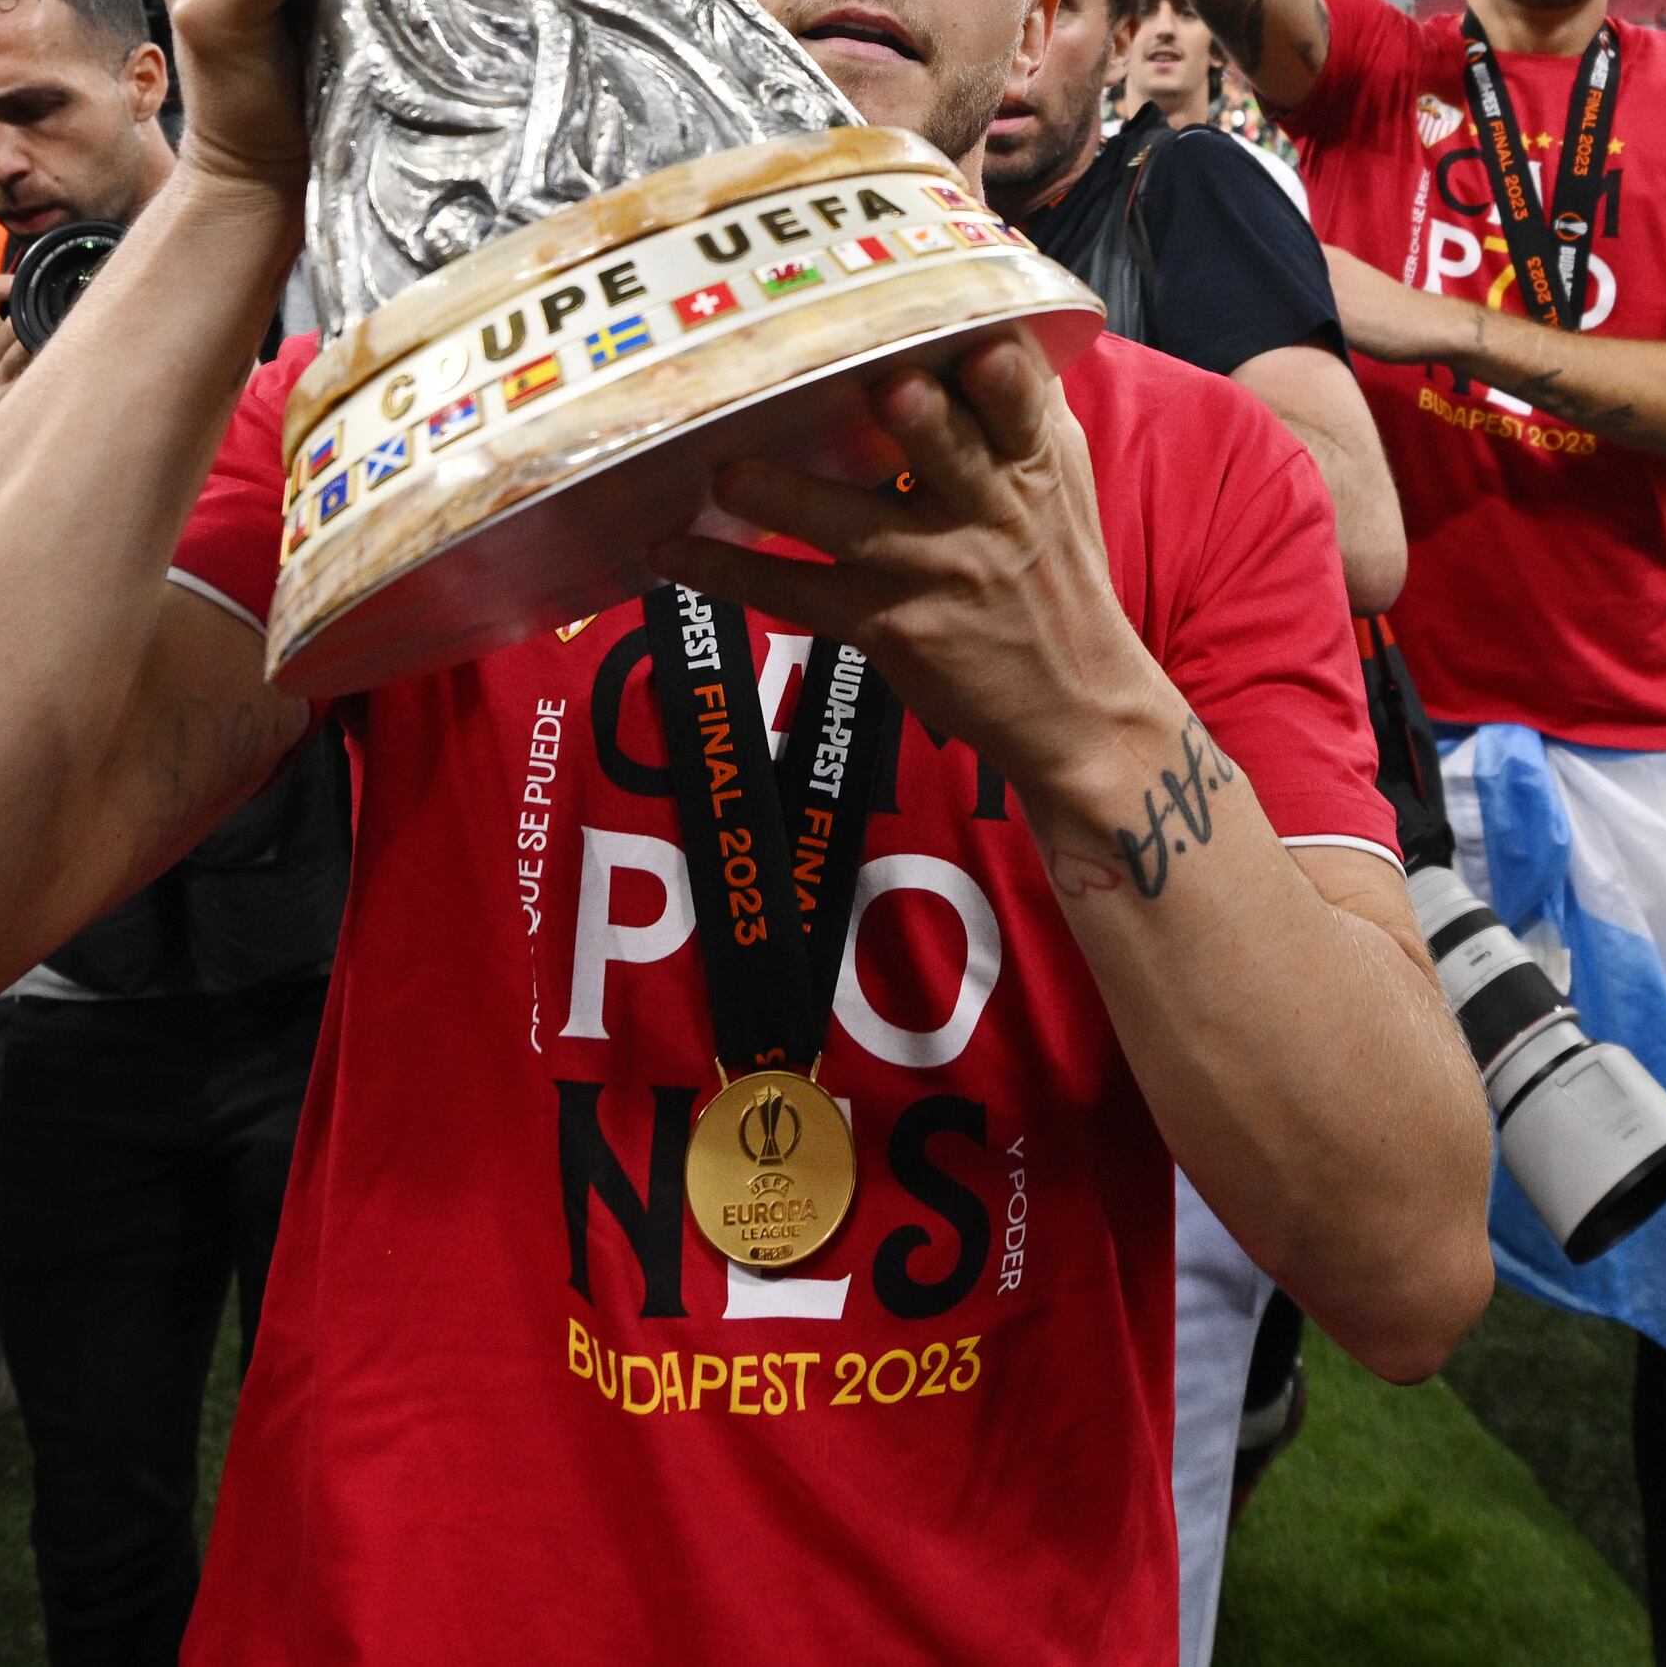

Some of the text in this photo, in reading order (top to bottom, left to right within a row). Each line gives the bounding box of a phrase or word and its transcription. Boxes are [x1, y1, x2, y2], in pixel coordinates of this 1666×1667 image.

[1573, 135, 1594, 177] 2023
[1581, 88, 1604, 131] FINAL
[1489, 119, 1515, 173] FINAL
[1503, 174, 1530, 222] 2023
[380, 185, 907, 423] COUPE UEFA
[1419, 386, 1525, 440] BUDAPEST
[1528, 421, 1598, 455] 2023
[523, 697, 567, 806] PUEDE
[516, 810, 551, 853] SE
[693, 682, 743, 819] FINAL
[718, 827, 768, 948] 2023
[792, 806, 834, 934] FINA
[721, 1197, 819, 1227] EUROPA
[740, 1224, 800, 1242] LEAGUE
[996, 1136, 1028, 1298] Y PODER
[567, 1316, 985, 1418] BUDAPEST 2023
